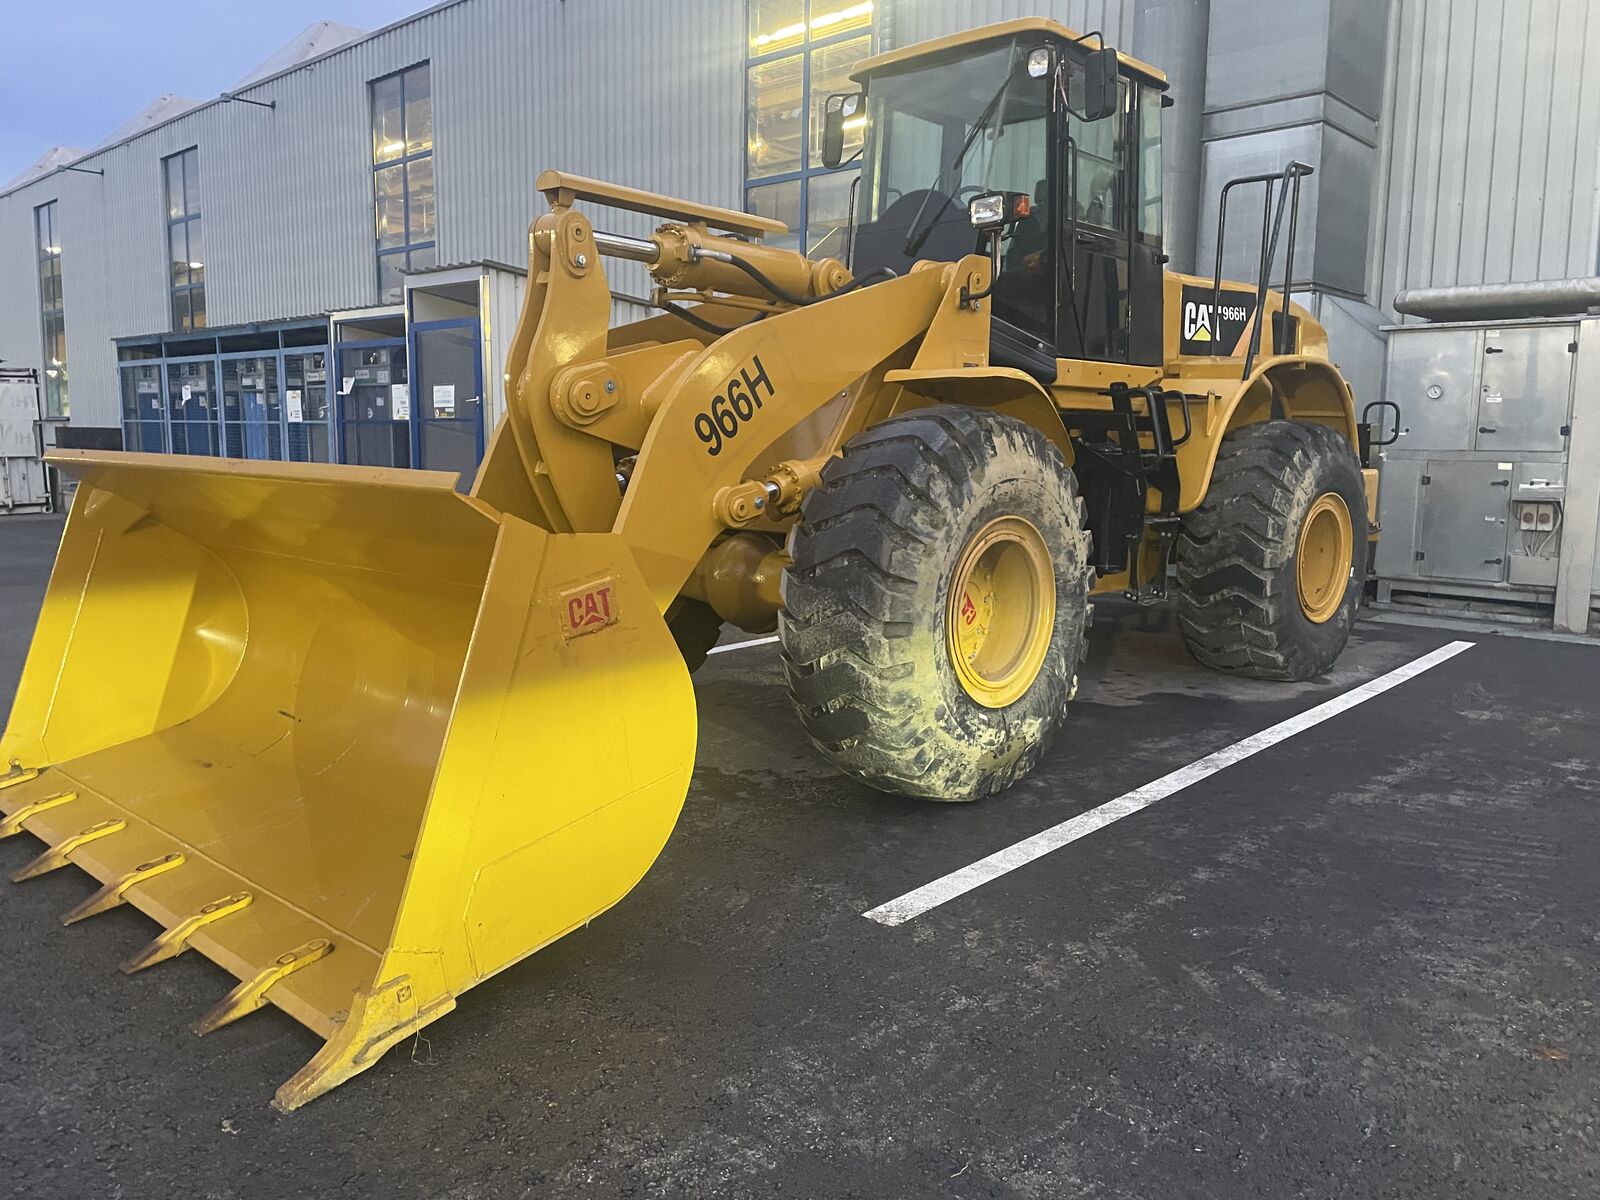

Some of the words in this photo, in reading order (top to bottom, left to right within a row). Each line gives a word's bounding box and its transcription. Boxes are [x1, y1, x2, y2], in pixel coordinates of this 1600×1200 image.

[1184, 301, 1222, 341] CAT
[1222, 306, 1246, 322] 966H
[694, 355, 775, 456] 966H
[568, 587, 610, 629] CAT
